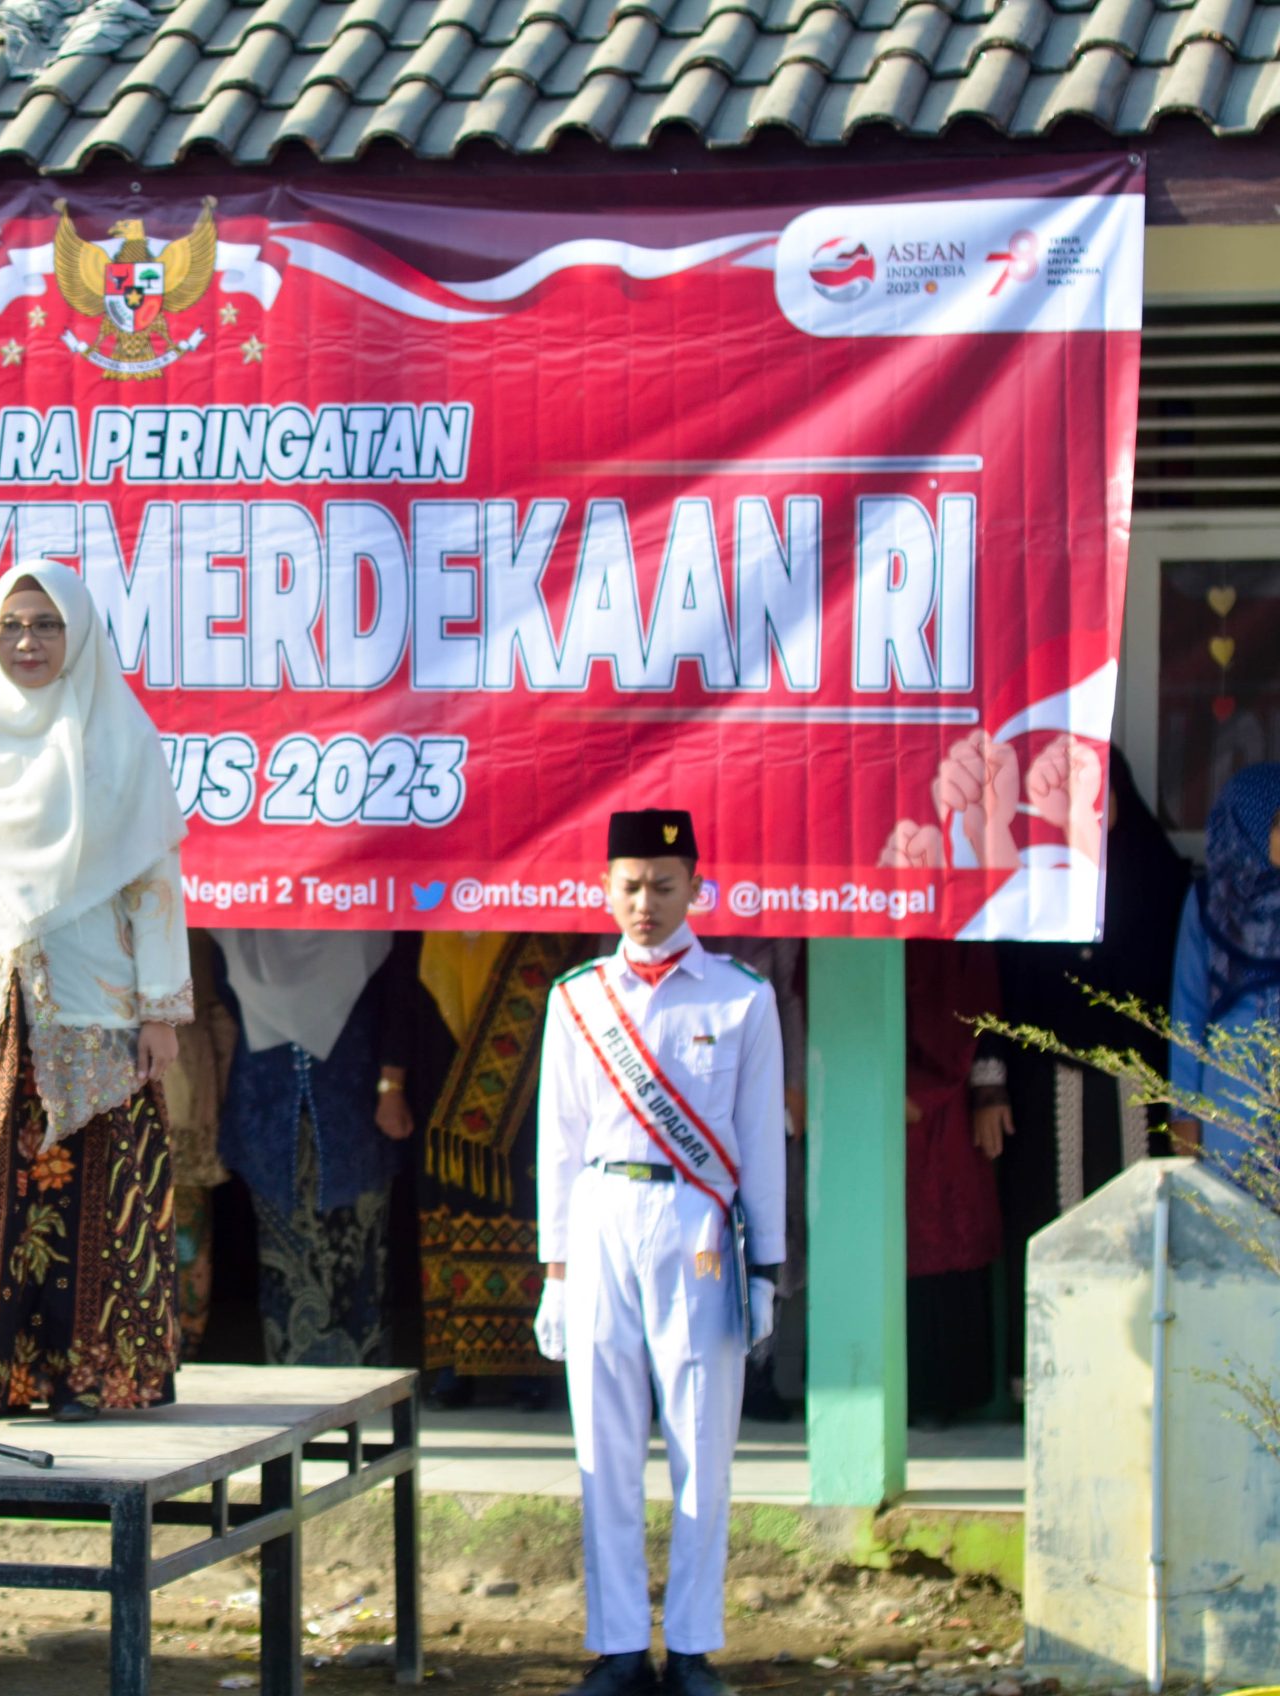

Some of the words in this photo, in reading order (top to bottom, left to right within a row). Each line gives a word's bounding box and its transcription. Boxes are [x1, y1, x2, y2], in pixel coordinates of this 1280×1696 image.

[886, 241, 966, 262] ASEAN
[886, 265, 966, 279] INDONESIA
[886, 281, 920, 295] 2023
[85, 401, 473, 485] PERINGATAN
[854, 493, 978, 693] RI
[259, 732, 468, 828] 2023
[181, 875, 268, 909] Negeri
[276, 876, 293, 904] 2
[300, 876, 377, 911] Tegal
[451, 878, 614, 914] @mtsn2te
[728, 880, 936, 919] @mtsn2tegal
[602, 1026, 656, 1098] PETUGAS
[648, 1095, 710, 1169] UPACARA
